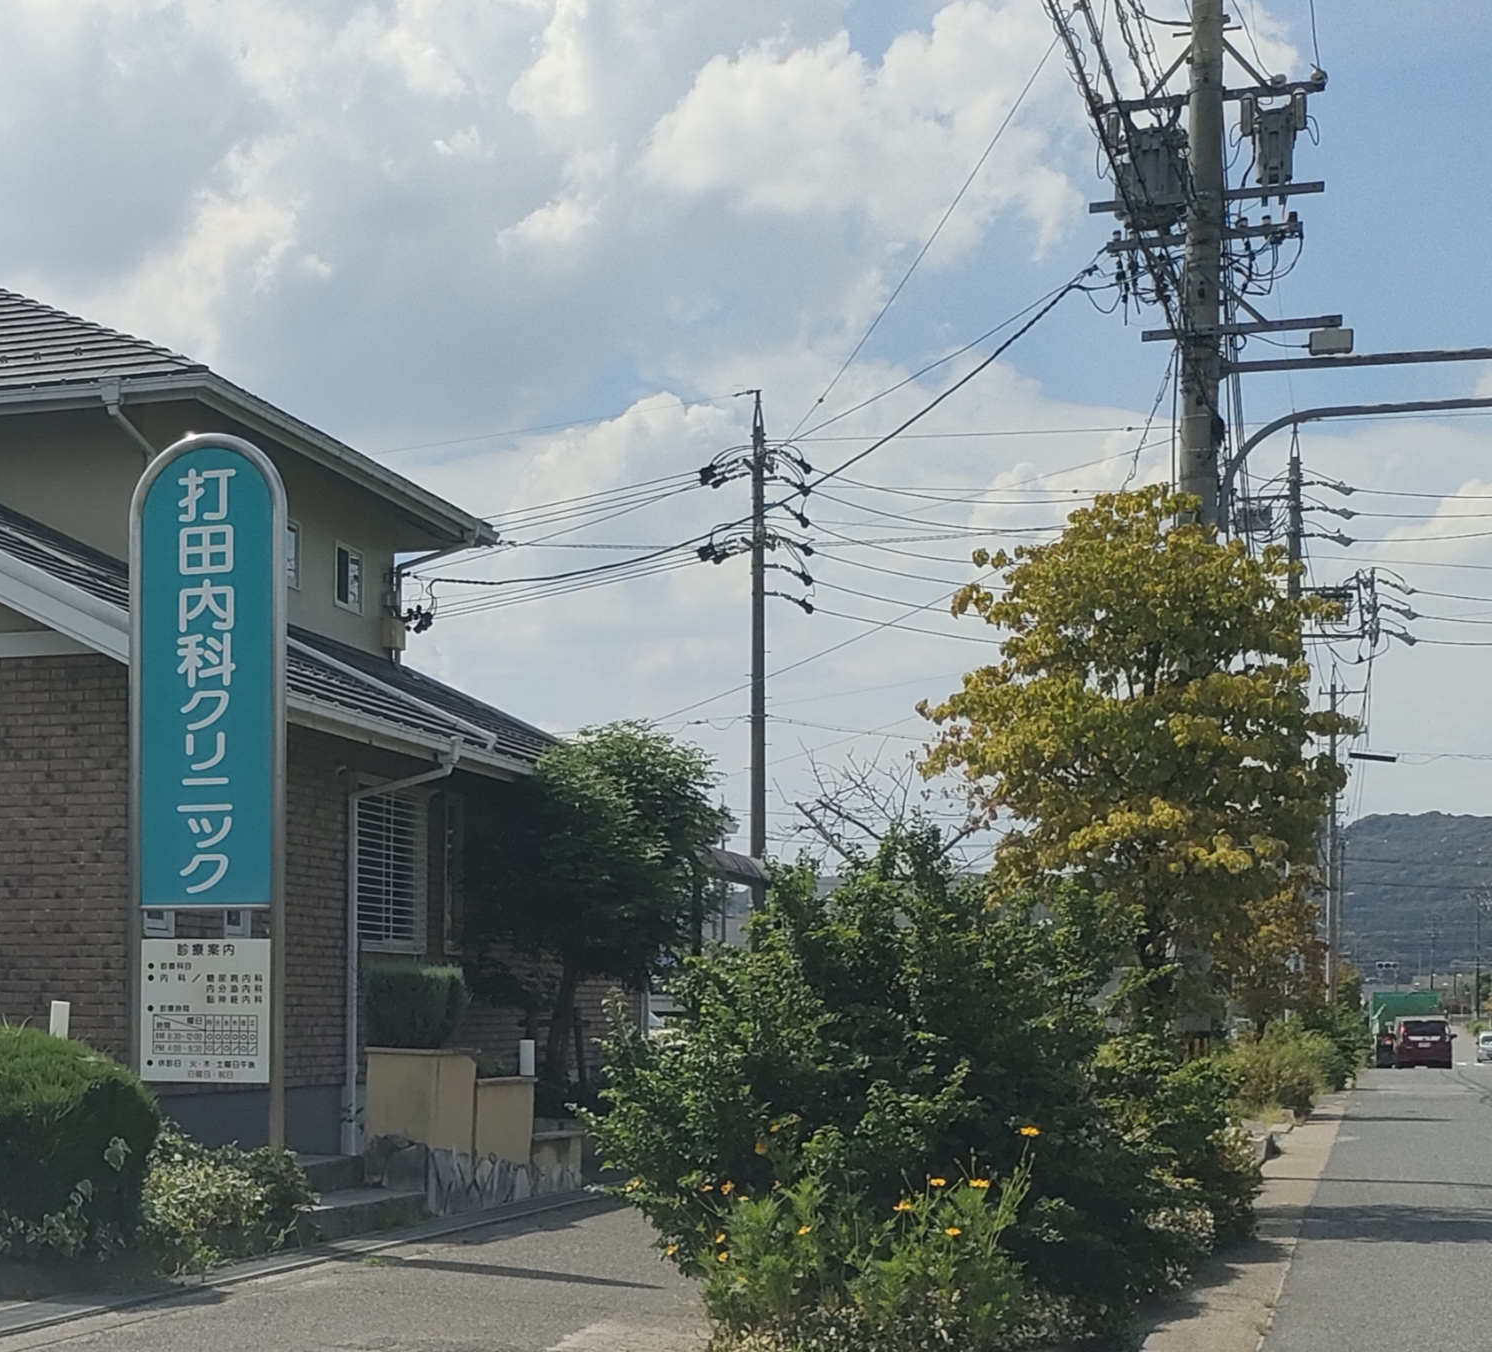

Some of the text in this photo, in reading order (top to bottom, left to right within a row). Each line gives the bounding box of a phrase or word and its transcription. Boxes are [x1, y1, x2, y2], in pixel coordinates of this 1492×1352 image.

[177, 468, 236, 894] 打田内科クリニック
[176, 943, 235, 956] 診療案内
